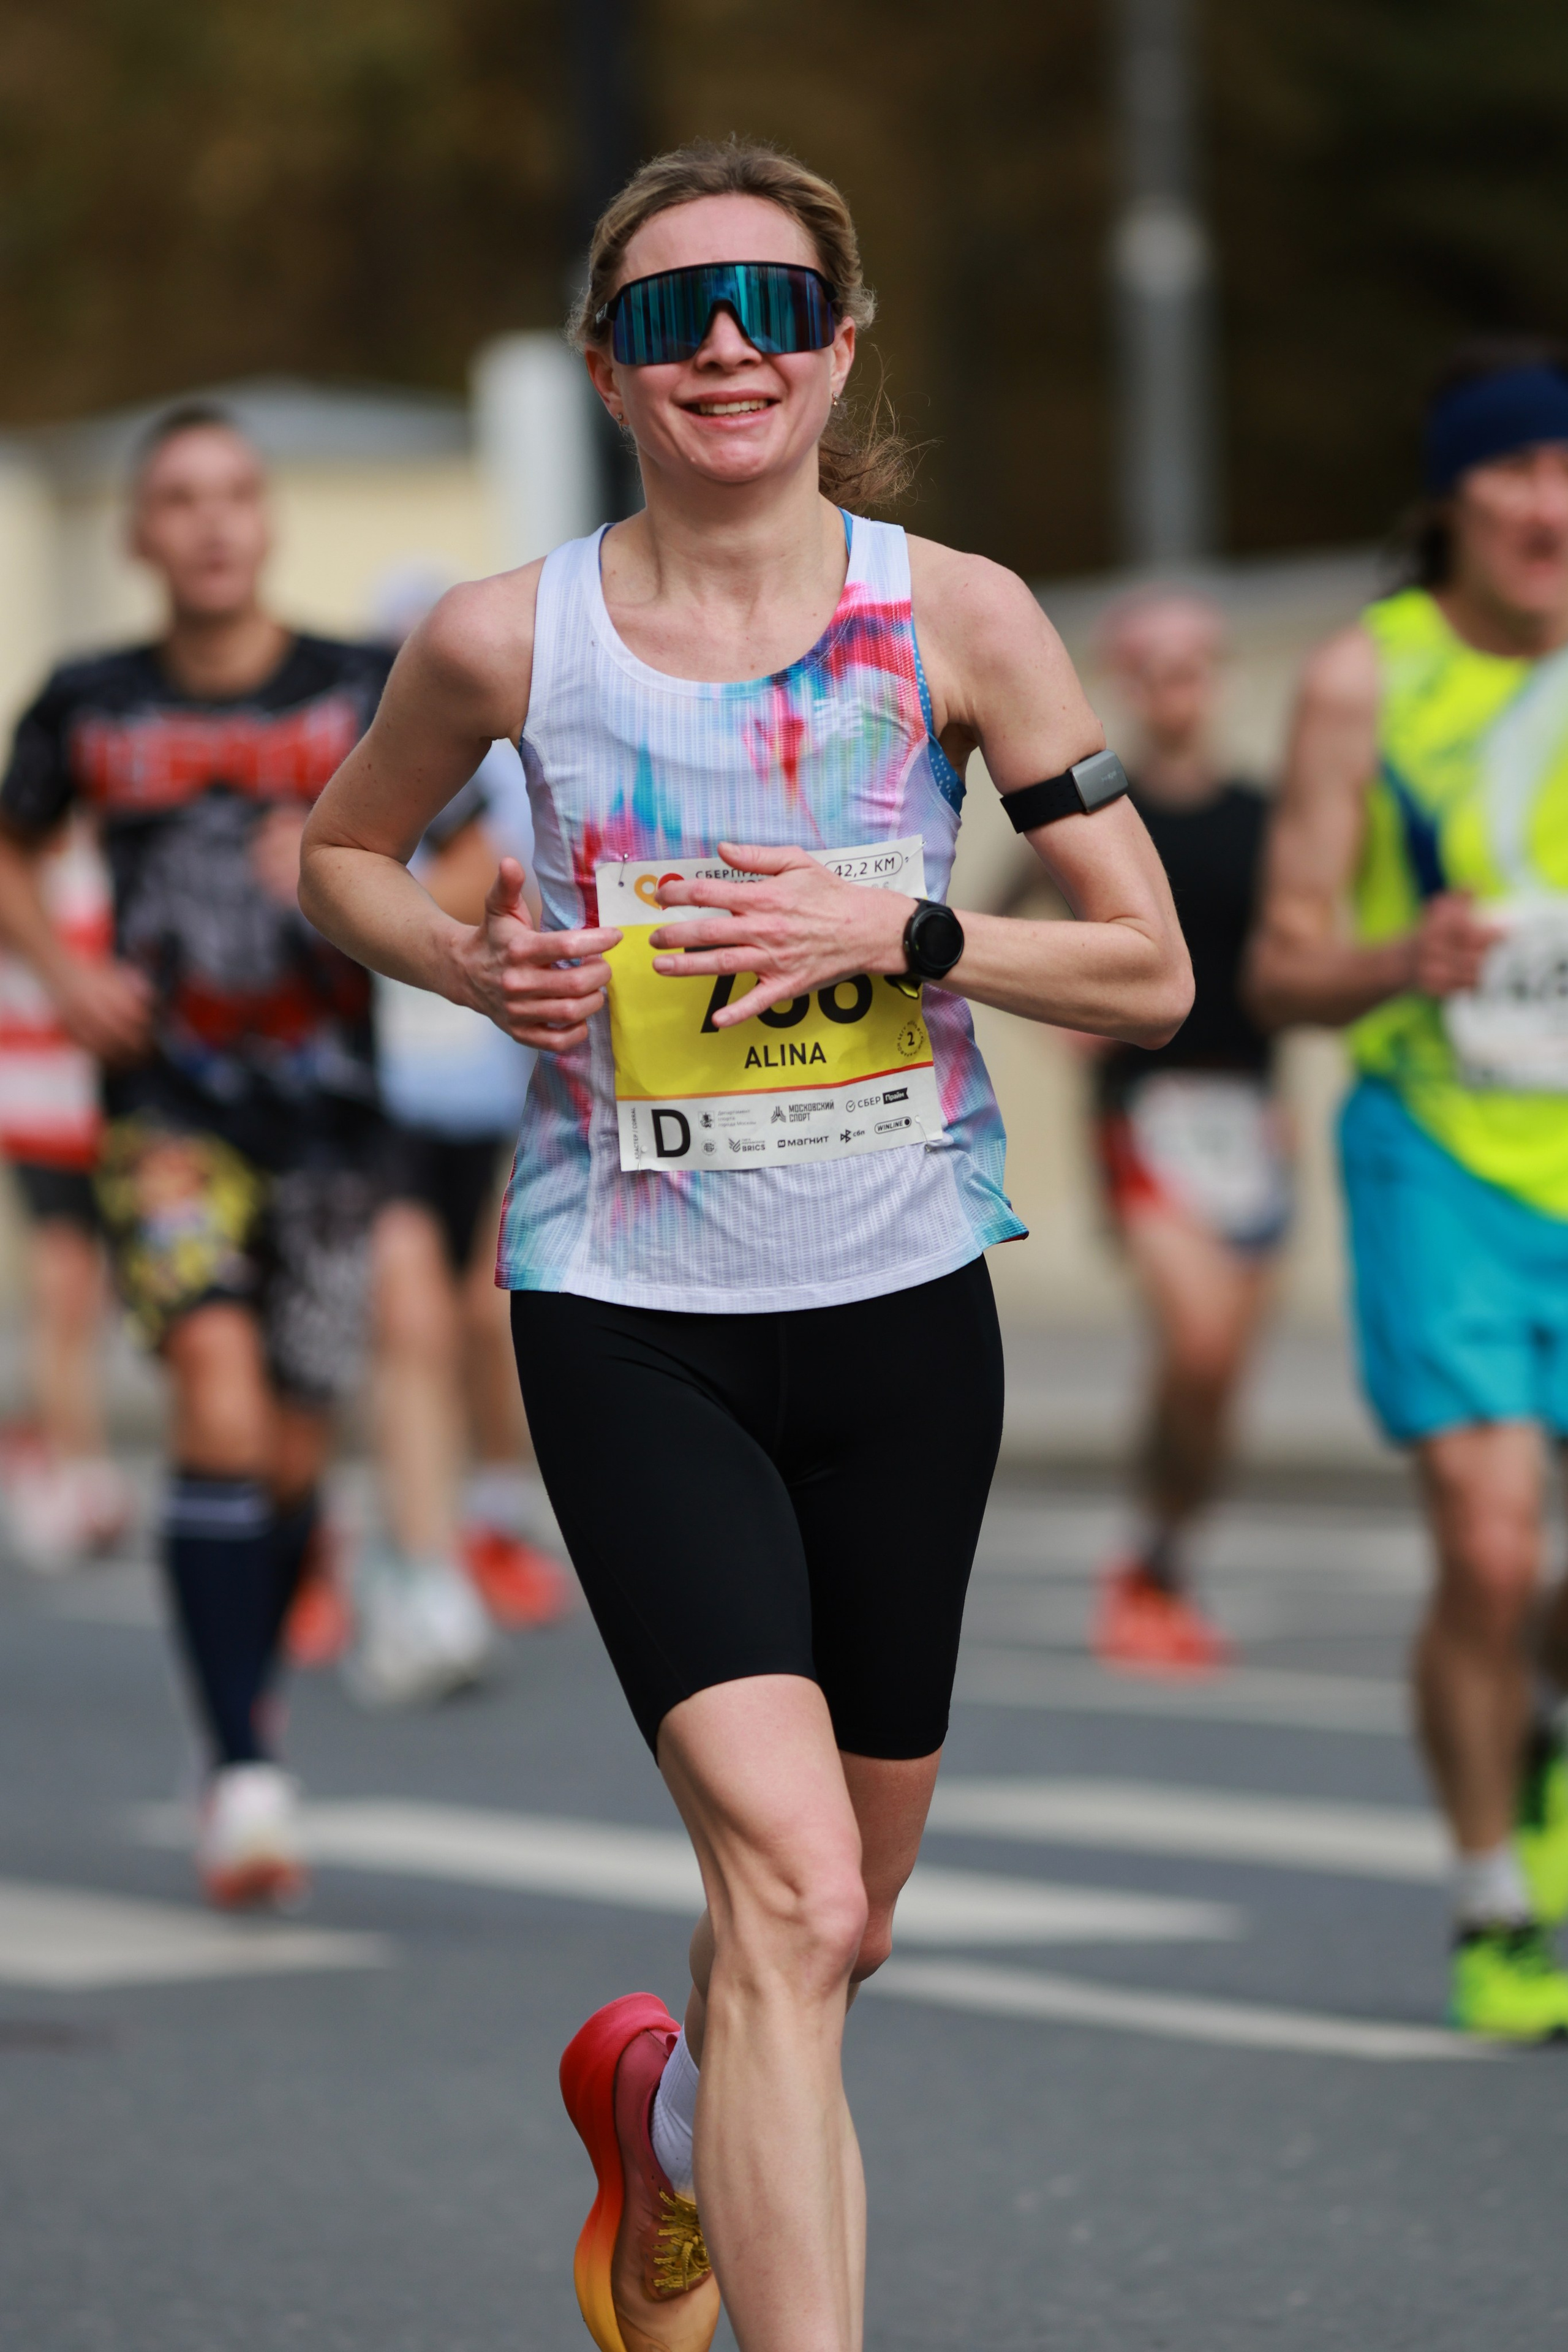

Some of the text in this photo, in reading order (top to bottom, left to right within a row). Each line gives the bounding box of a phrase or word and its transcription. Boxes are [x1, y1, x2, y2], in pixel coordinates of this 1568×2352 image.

[834, 862, 867, 877] 42,2
[907, 1031, 915, 1046] 2
[745, 1042, 826, 1069] ALINA
[789, 1099, 834, 1113] МОСКОВСКИЙ
[858, 1091, 905, 1107] СБЕР Прайм
[789, 1113, 810, 1122] СПОРТ
[651, 1109, 690, 1158] D
[877, 1120, 903, 1132] WINLINE
